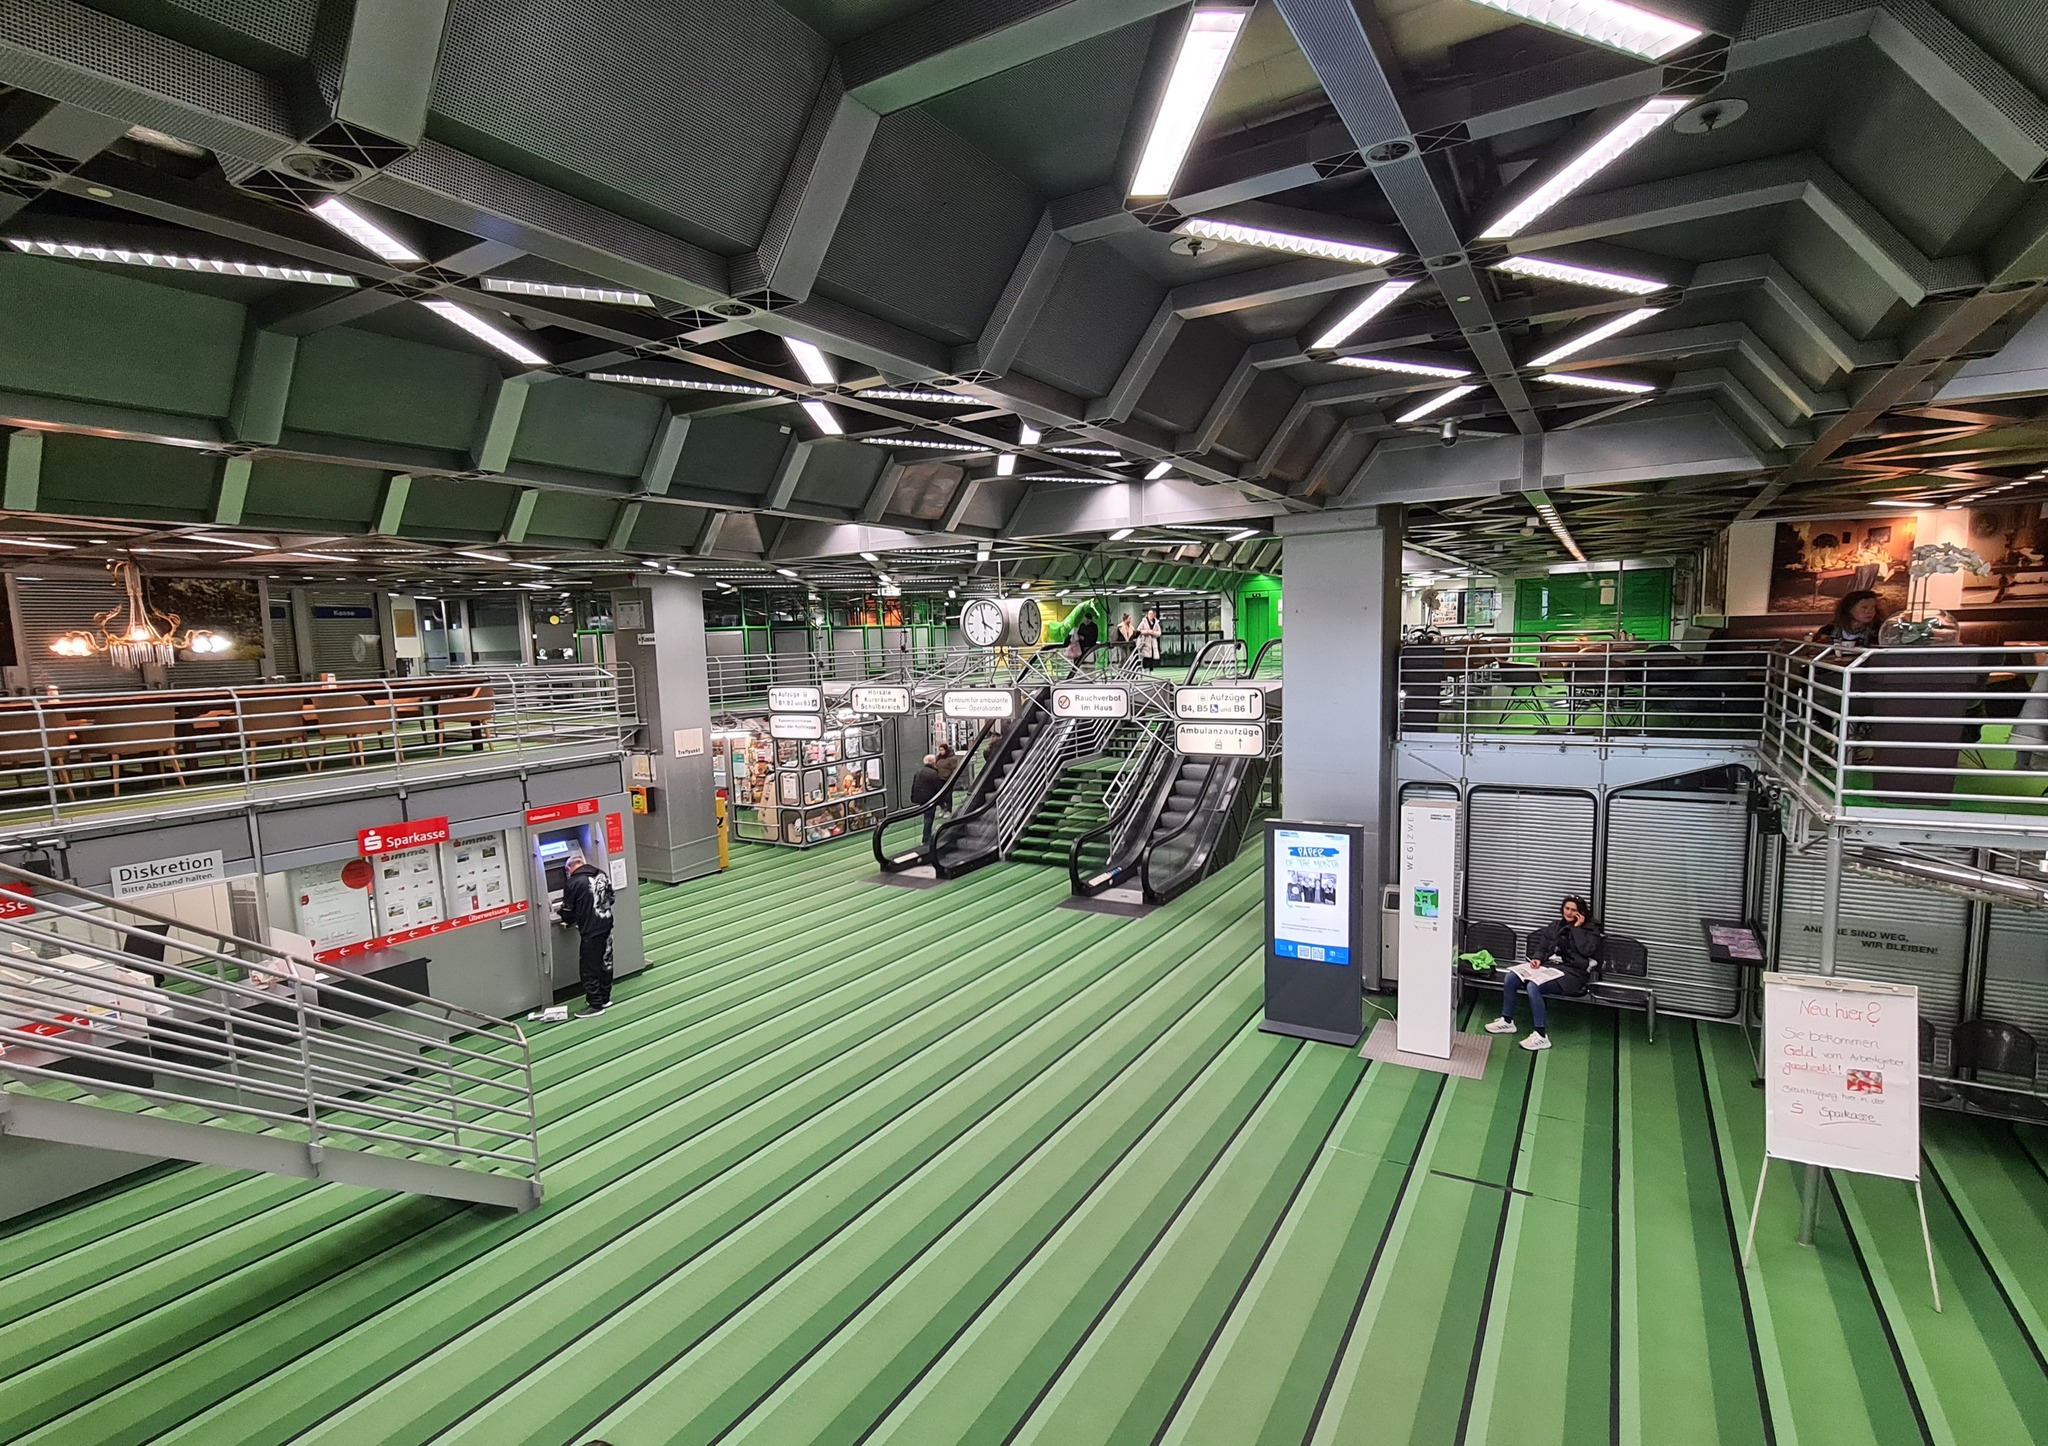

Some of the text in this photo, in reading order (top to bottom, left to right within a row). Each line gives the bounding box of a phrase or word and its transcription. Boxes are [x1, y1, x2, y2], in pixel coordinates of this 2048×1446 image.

[333, 609, 356, 617] Kasse
[979, 696, 1008, 704] ambulante
[1075, 694, 1122, 702] Rauchverbot
[1210, 694, 1245, 703] Aufzüge
[861, 703, 901, 711] Schulbereich
[969, 704, 1002, 713] Operationen
[1181, 704, 1195, 713] B4,
[1197, 704, 1208, 712] B5
[1234, 704, 1245, 712] B6
[1180, 726, 1260, 737] Ambulanzaufzüge
[386, 829, 446, 849] Sparkasse
[462, 833, 496, 846] immo.
[391, 848, 429, 861] immo.
[1297, 847, 1324, 857] PAPER
[120, 857, 213, 882] Diskretion
[1313, 860, 1339, 869] MONTH
[122, 873, 215, 895] Bitte Abstand halten.
[468, 907, 510, 922] Überweisung
[1851, 929, 1877, 939] SIND
[1880, 932, 1909, 942] WEG,
[1861, 940, 1939, 955] WIR BLEIBEN!
[1800, 999, 1831, 1018] Neu
[1809, 1031, 1881, 1050] bekommen
[1784, 1044, 1817, 1059] Geld
[1823, 1052, 1843, 1060] vom
[1818, 1106, 1877, 1123] Sparkasse
